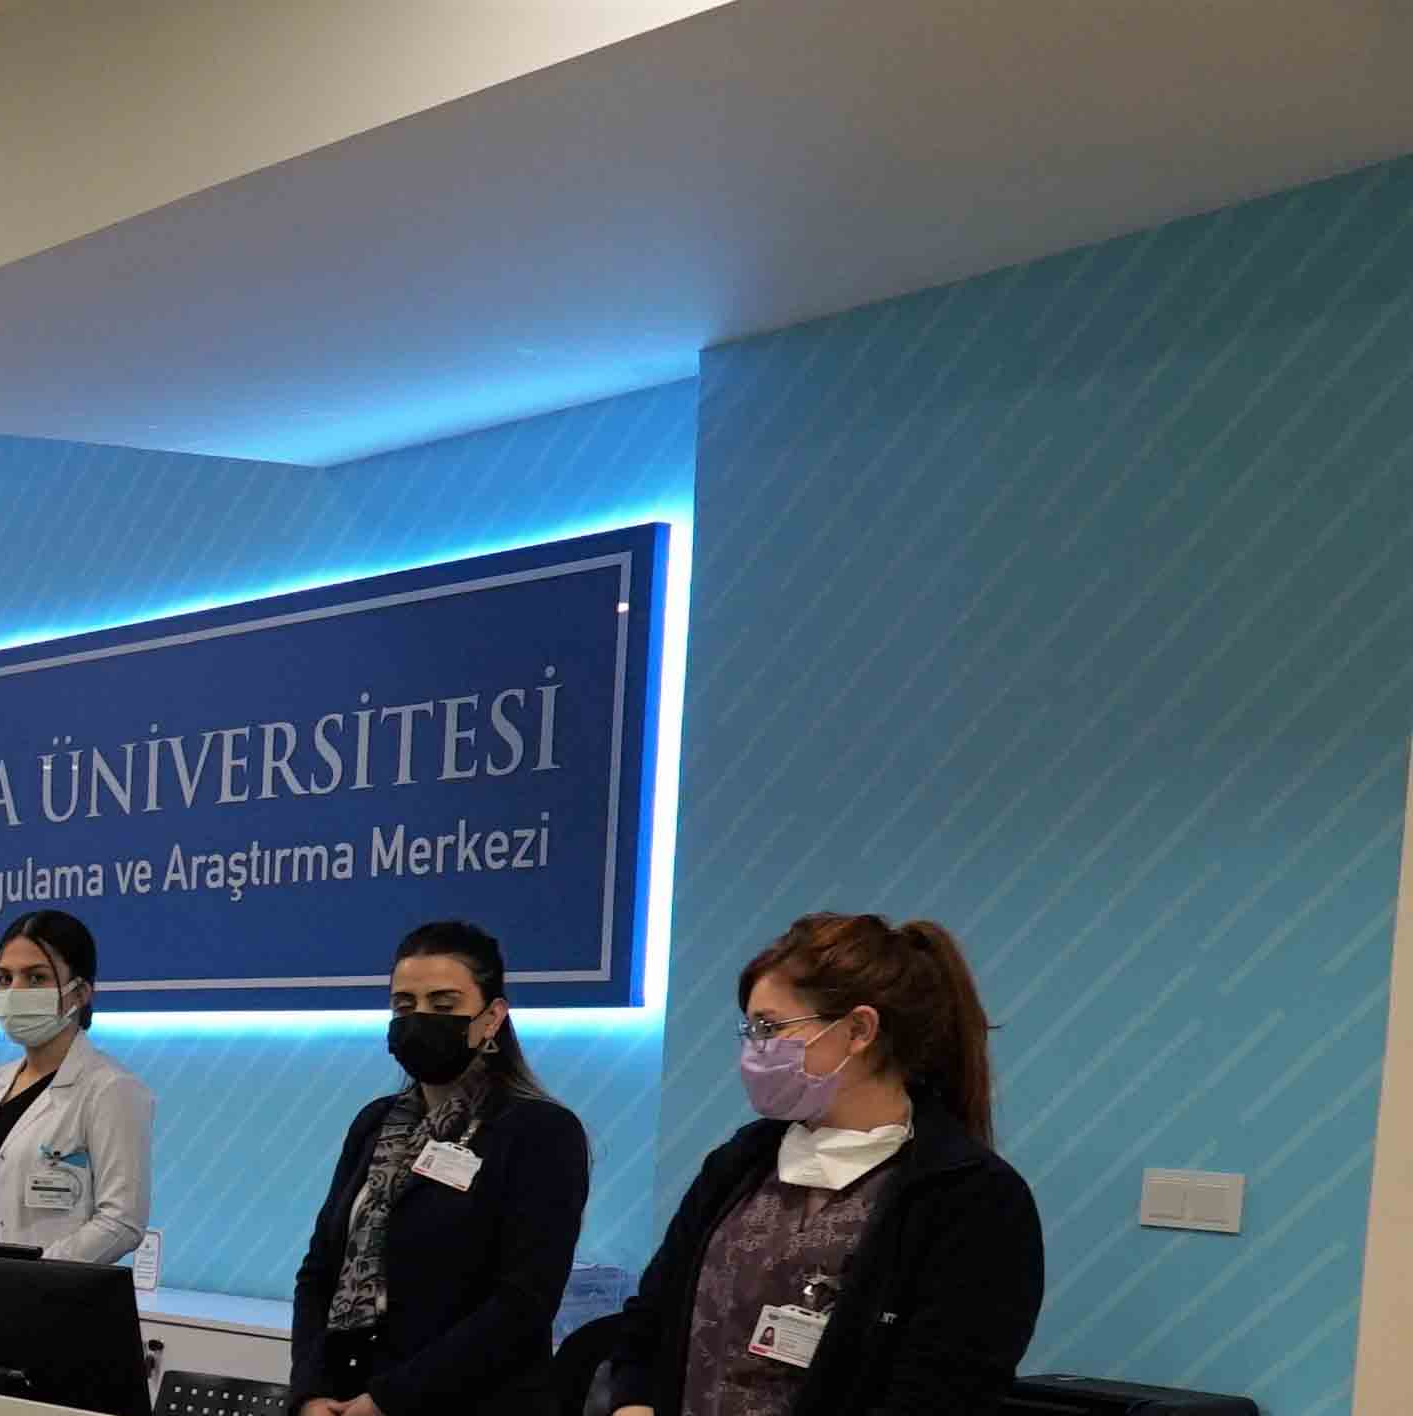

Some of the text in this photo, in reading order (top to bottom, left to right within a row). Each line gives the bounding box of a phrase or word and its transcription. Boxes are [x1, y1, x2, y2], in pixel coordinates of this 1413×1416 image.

[36, 664, 563, 824] ÜNİVERSİTESİ
[114, 858, 153, 896] ve
[161, 840, 354, 902] Araştırma
[370, 811, 550, 879] Merkezi
